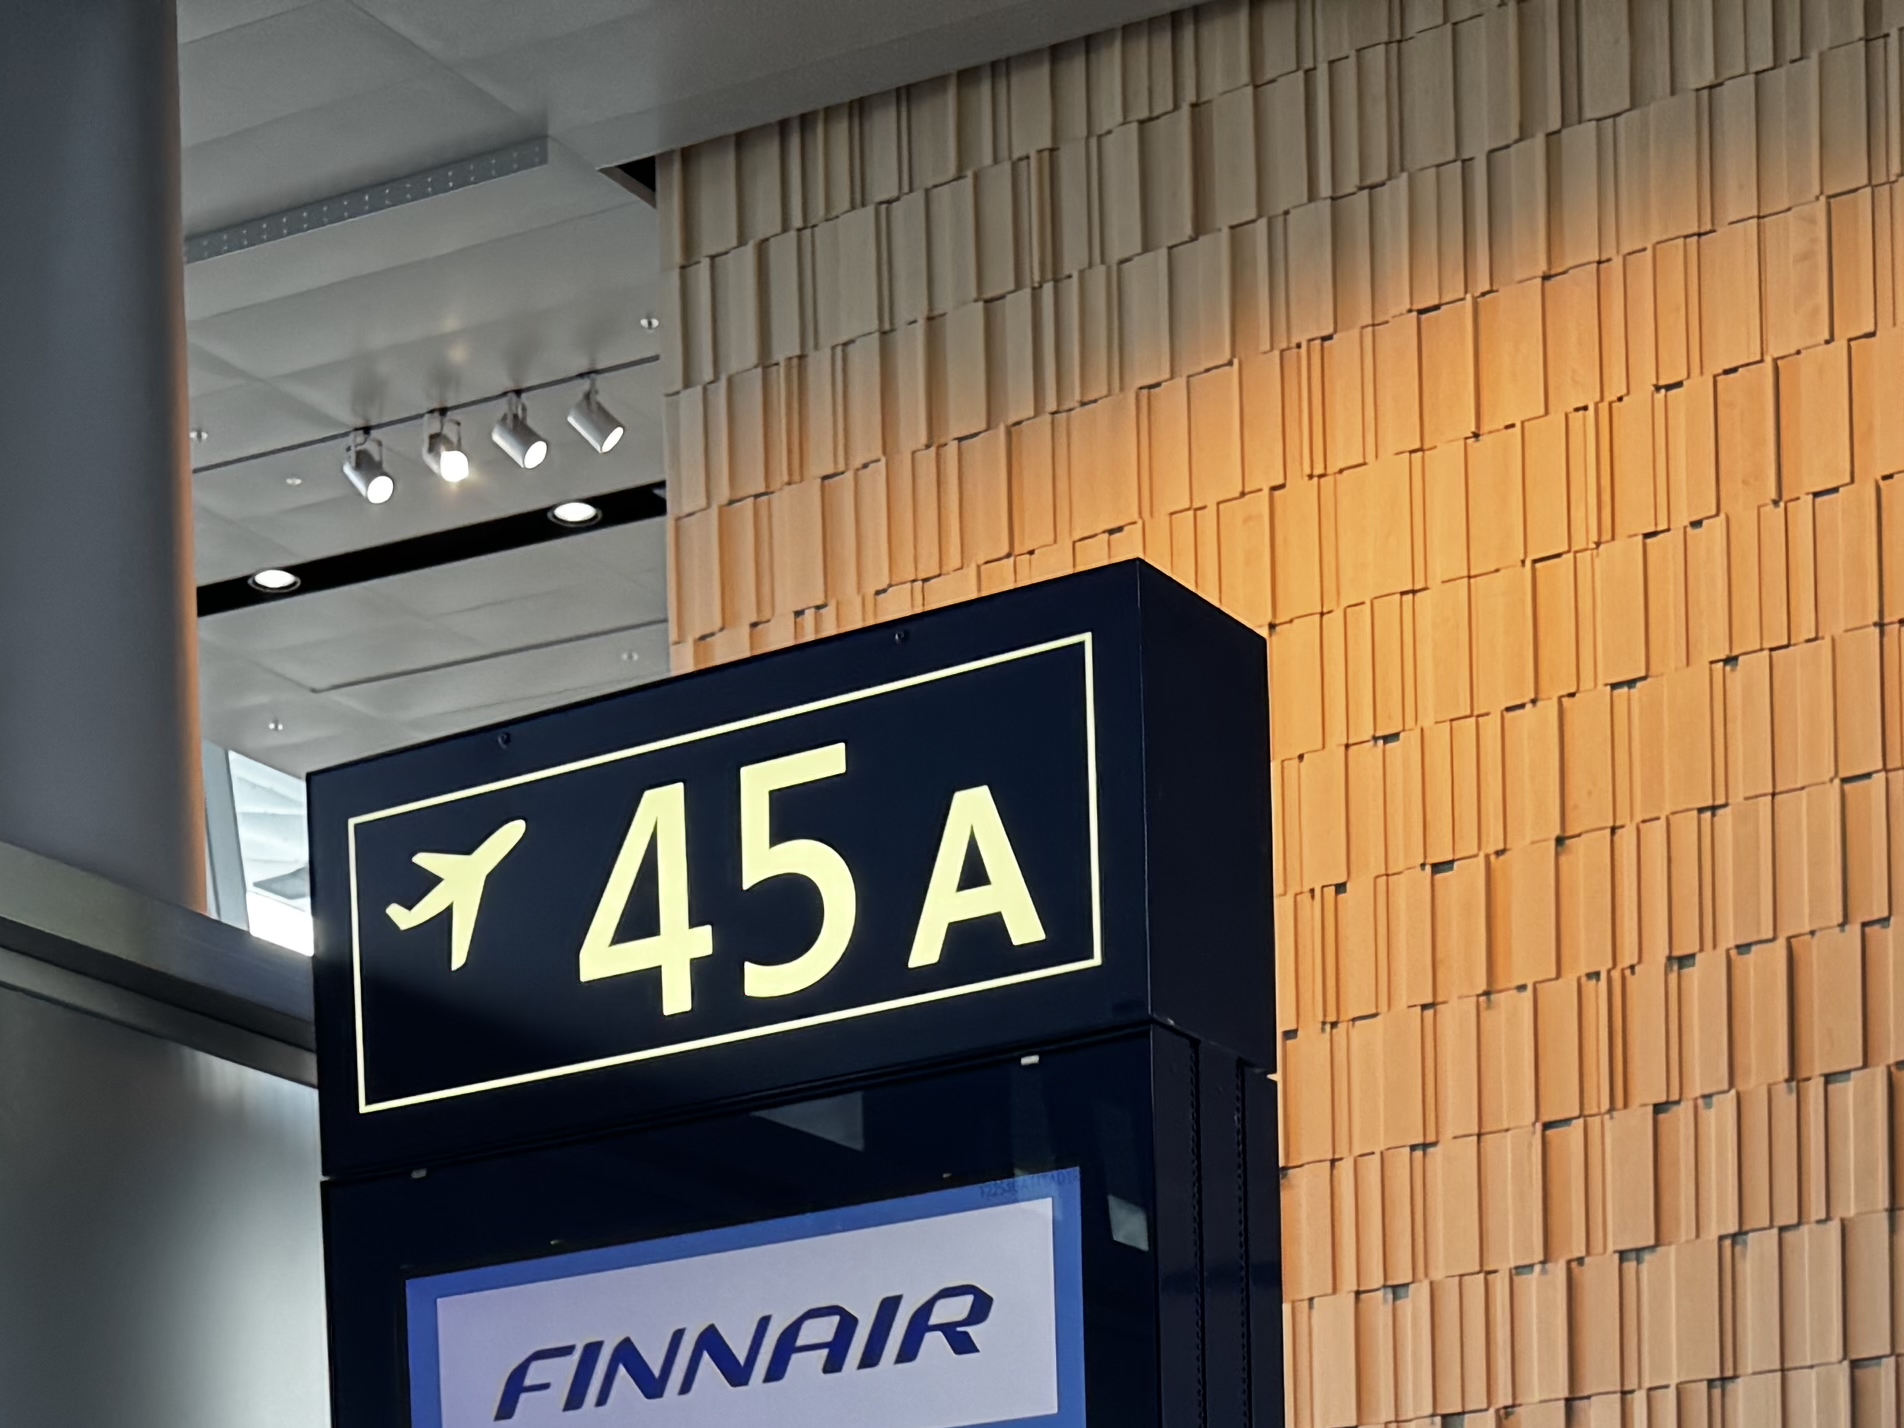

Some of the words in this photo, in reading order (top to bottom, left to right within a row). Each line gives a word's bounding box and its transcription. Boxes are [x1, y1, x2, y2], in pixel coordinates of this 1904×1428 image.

[578, 741, 858, 1016] 45
[907, 784, 1047, 969] A
[493, 1283, 995, 1422] FINNAIR
